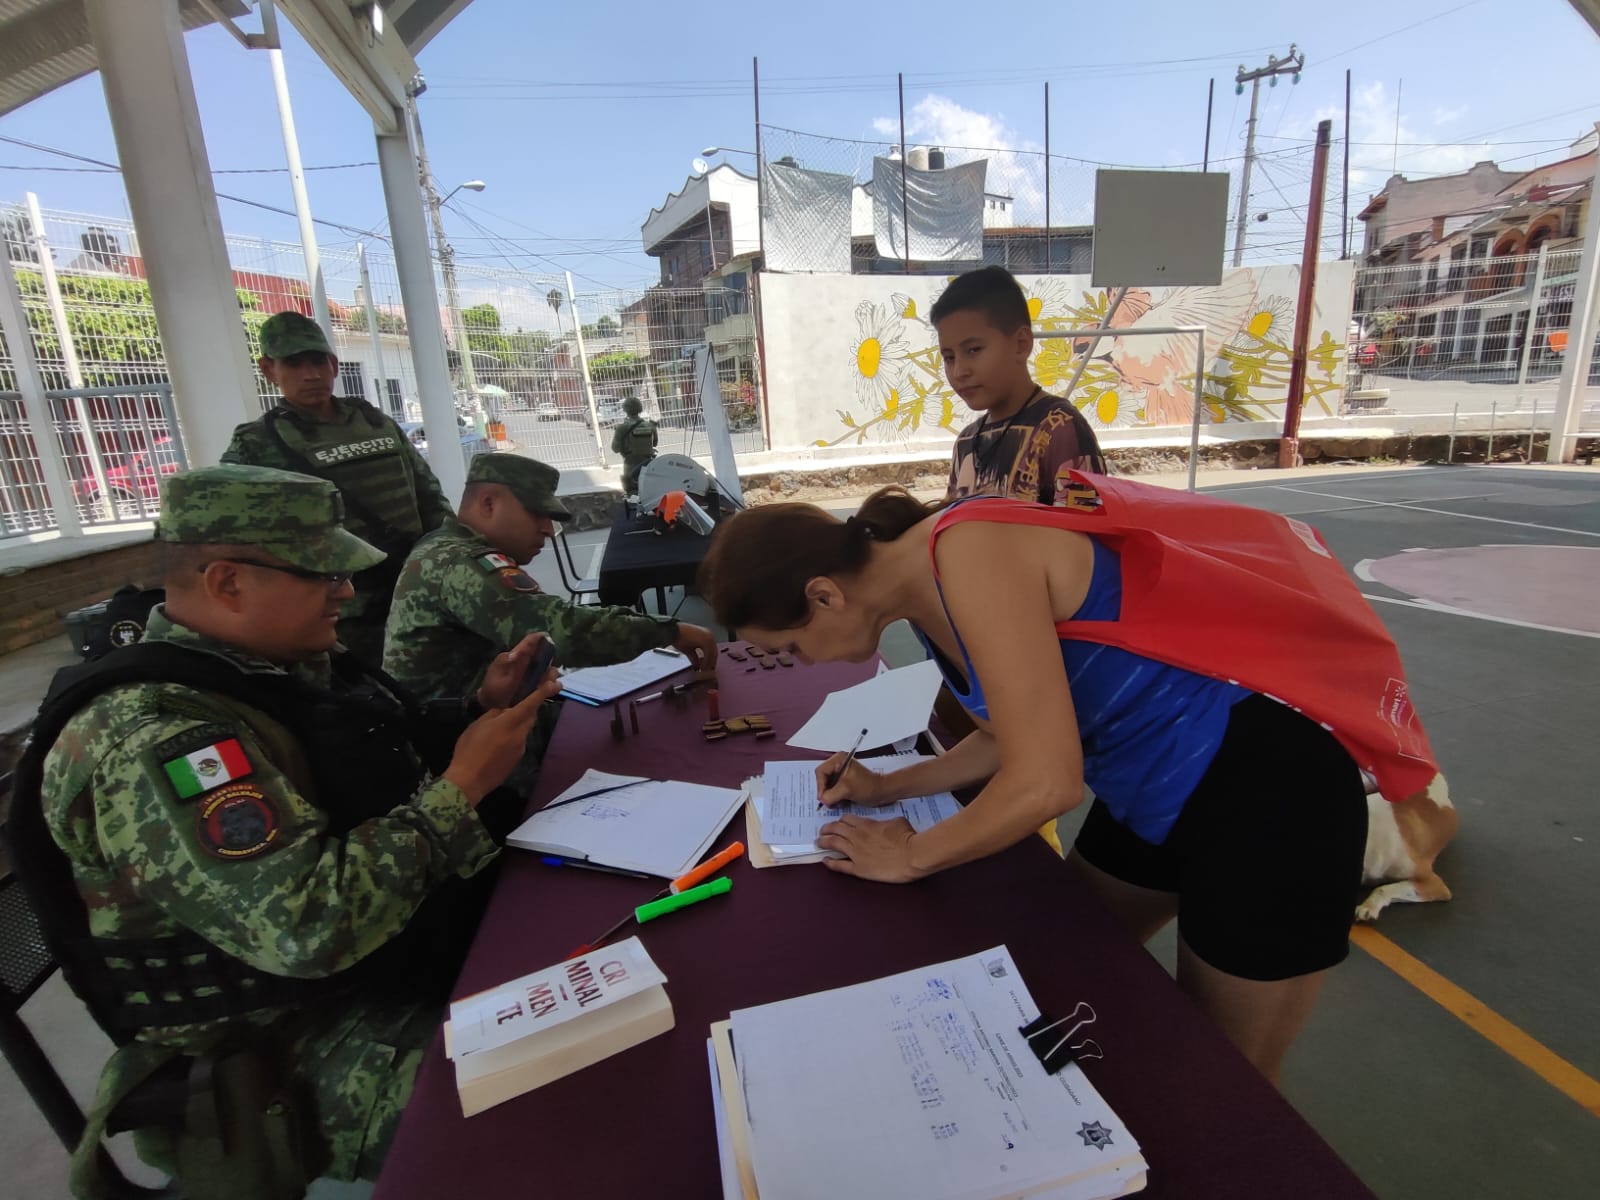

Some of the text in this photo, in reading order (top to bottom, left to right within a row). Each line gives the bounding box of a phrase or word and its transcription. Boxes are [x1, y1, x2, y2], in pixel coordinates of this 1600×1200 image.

[326, 444, 394, 463] MEXICANO
[564, 960, 603, 1008] MINAL
[599, 960, 631, 987] CRI
[496, 1001, 523, 1025] TE
[526, 981, 559, 1019] MEN
